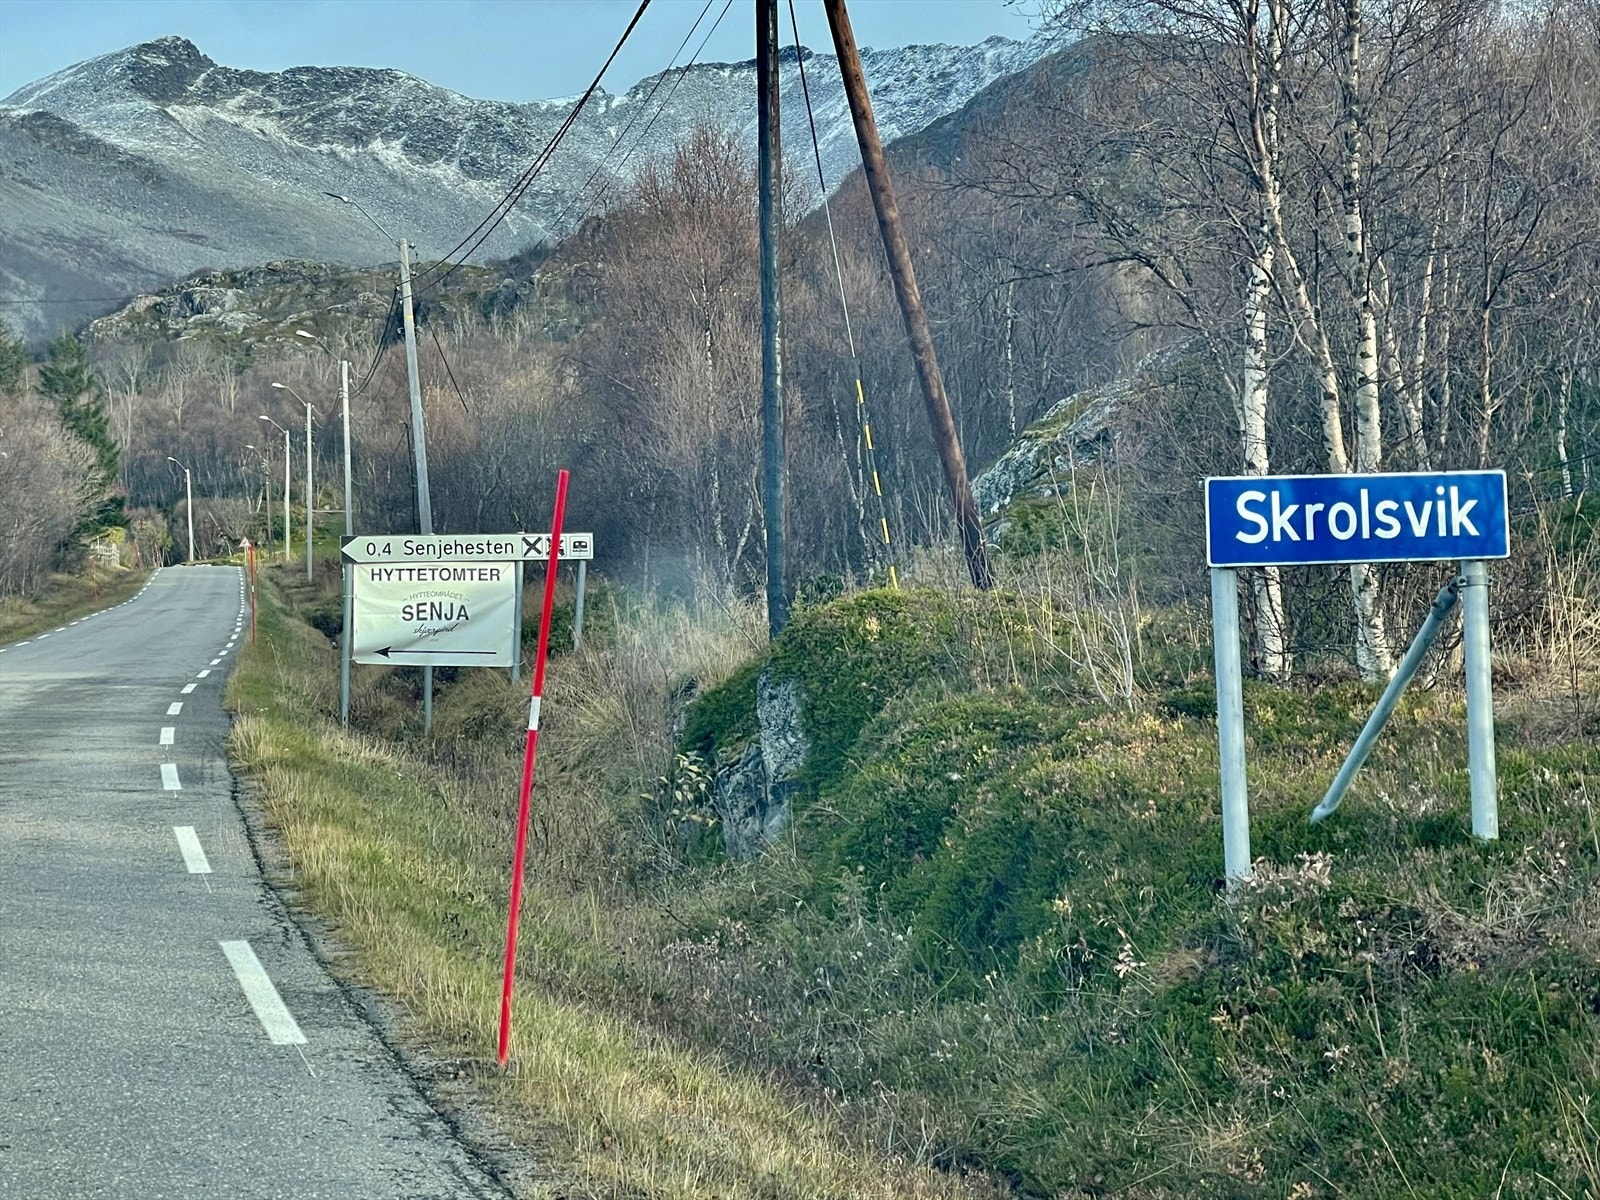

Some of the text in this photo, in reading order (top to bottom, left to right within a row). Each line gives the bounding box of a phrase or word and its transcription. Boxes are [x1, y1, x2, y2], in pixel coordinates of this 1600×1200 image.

[1235, 485, 1480, 544] Skrolsvik
[403, 539, 514, 560] Senjehesten
[371, 567, 501, 582] HYTTETOMTER
[409, 590, 463, 600] HYTTEOMRÅDET
[402, 601, 469, 621] SENJA
